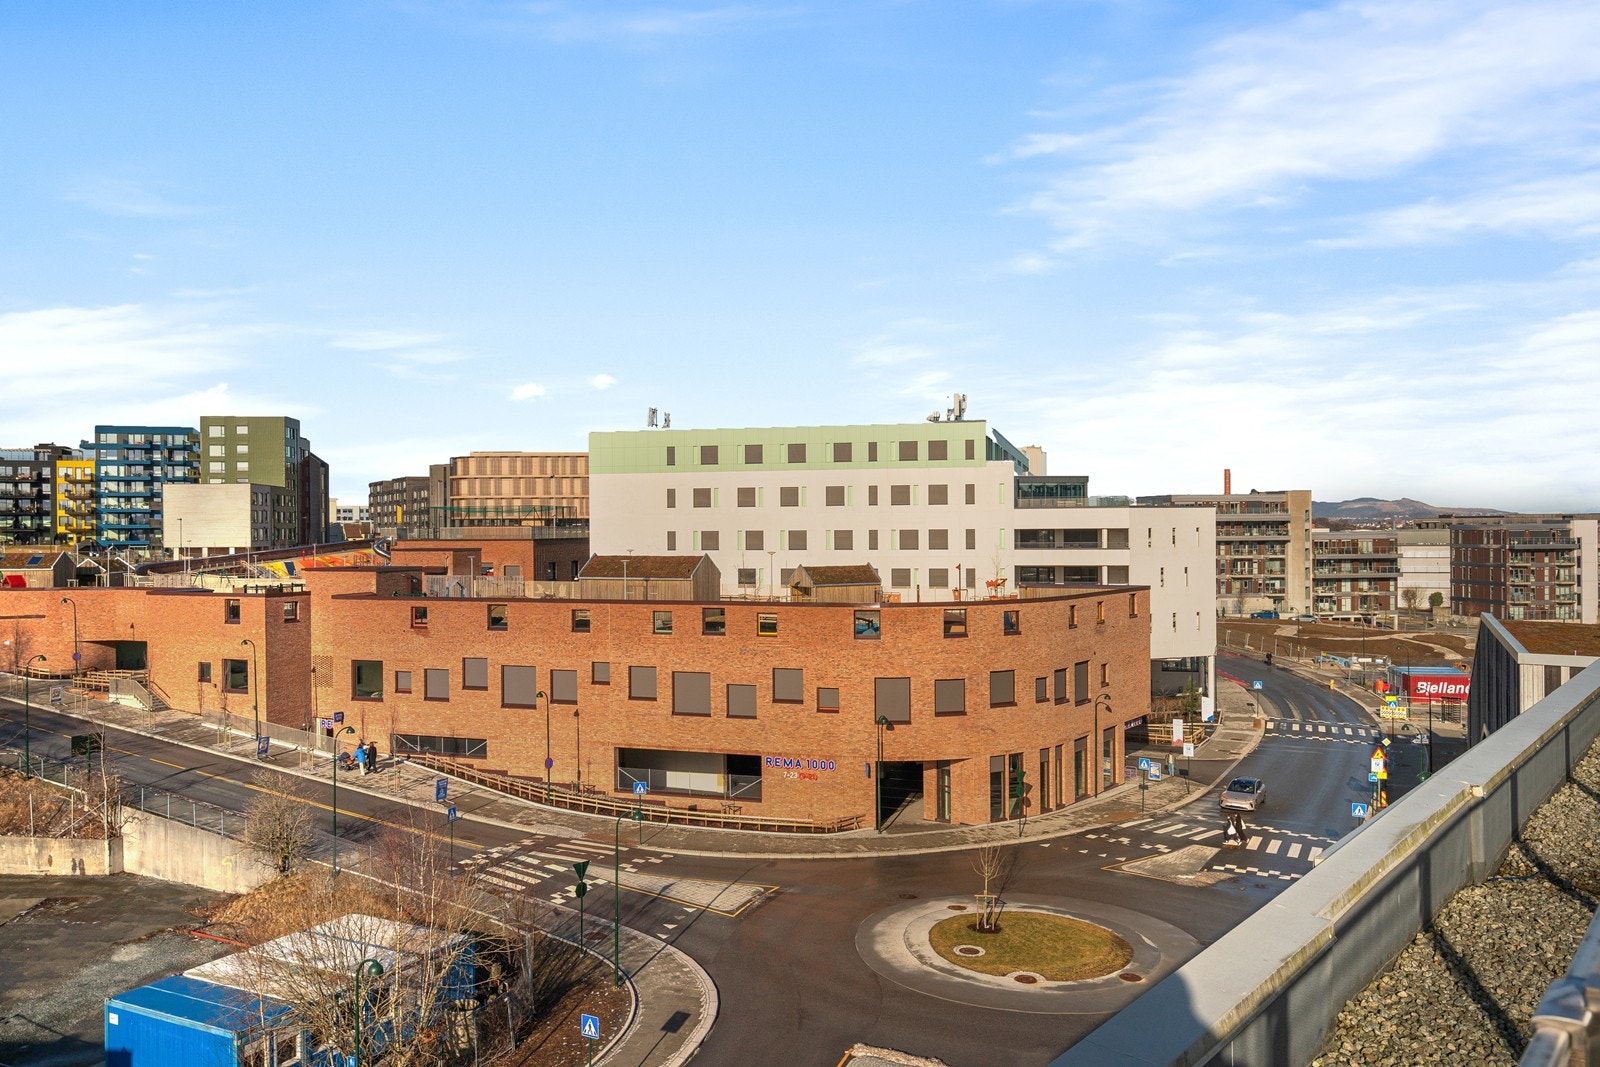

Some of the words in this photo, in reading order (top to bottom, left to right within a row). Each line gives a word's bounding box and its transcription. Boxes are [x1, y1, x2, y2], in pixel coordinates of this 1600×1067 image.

[765, 757, 802, 768] REMA
[806, 759, 835, 771] 1000
[783, 771, 798, 779] 7-23
